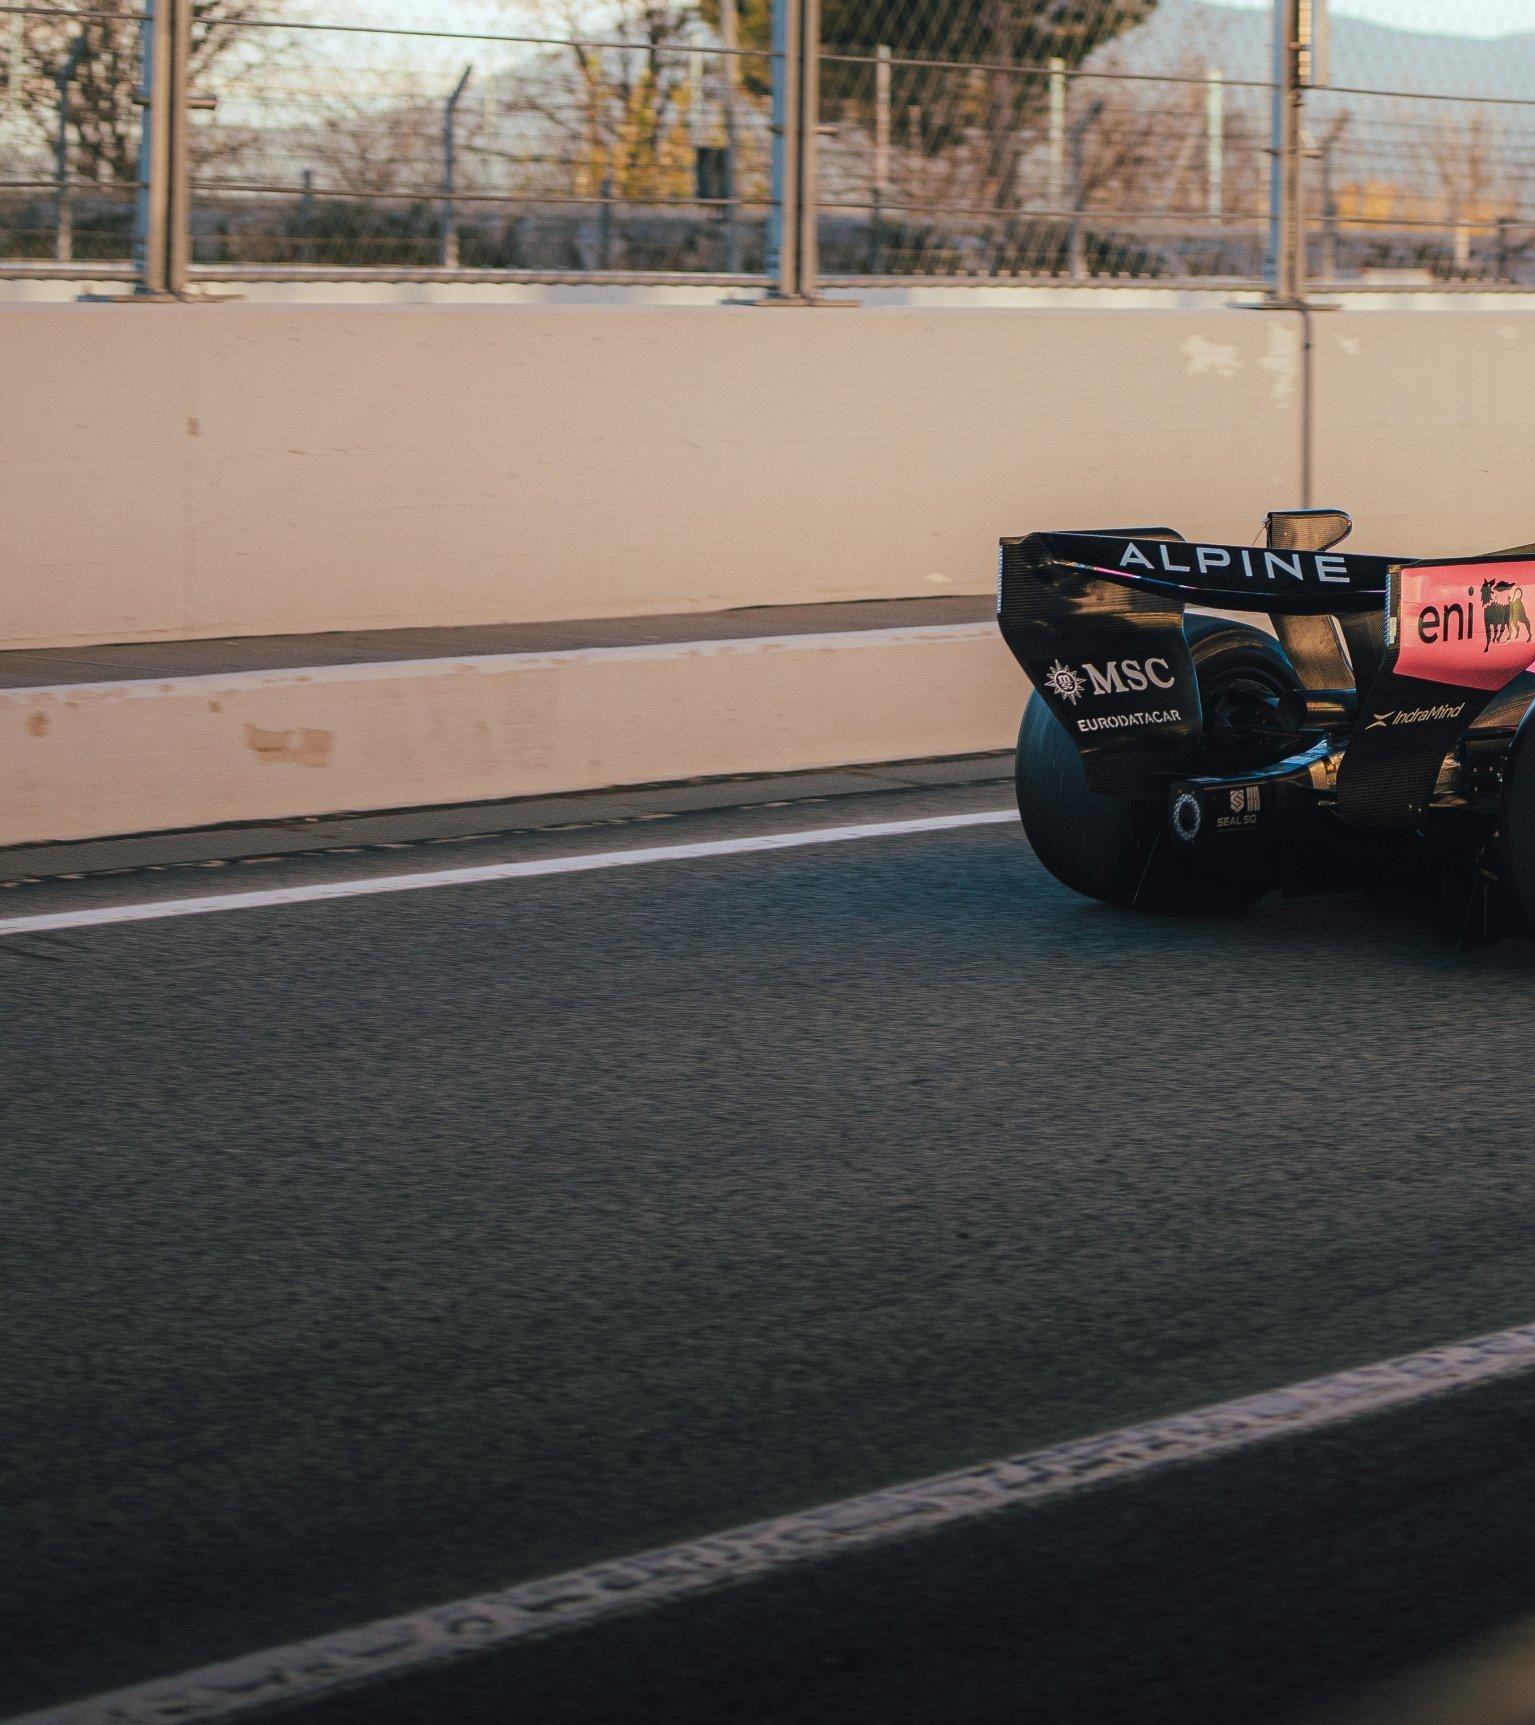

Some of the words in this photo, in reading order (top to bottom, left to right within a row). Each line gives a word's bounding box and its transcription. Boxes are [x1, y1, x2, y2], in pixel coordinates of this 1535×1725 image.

[1119, 542, 1350, 583] ALPINE
[1418, 586, 1475, 644] eni
[1081, 658, 1175, 695] MSC
[1077, 709, 1181, 732] EURODATACAR
[1392, 702, 1465, 725] IndraMind
